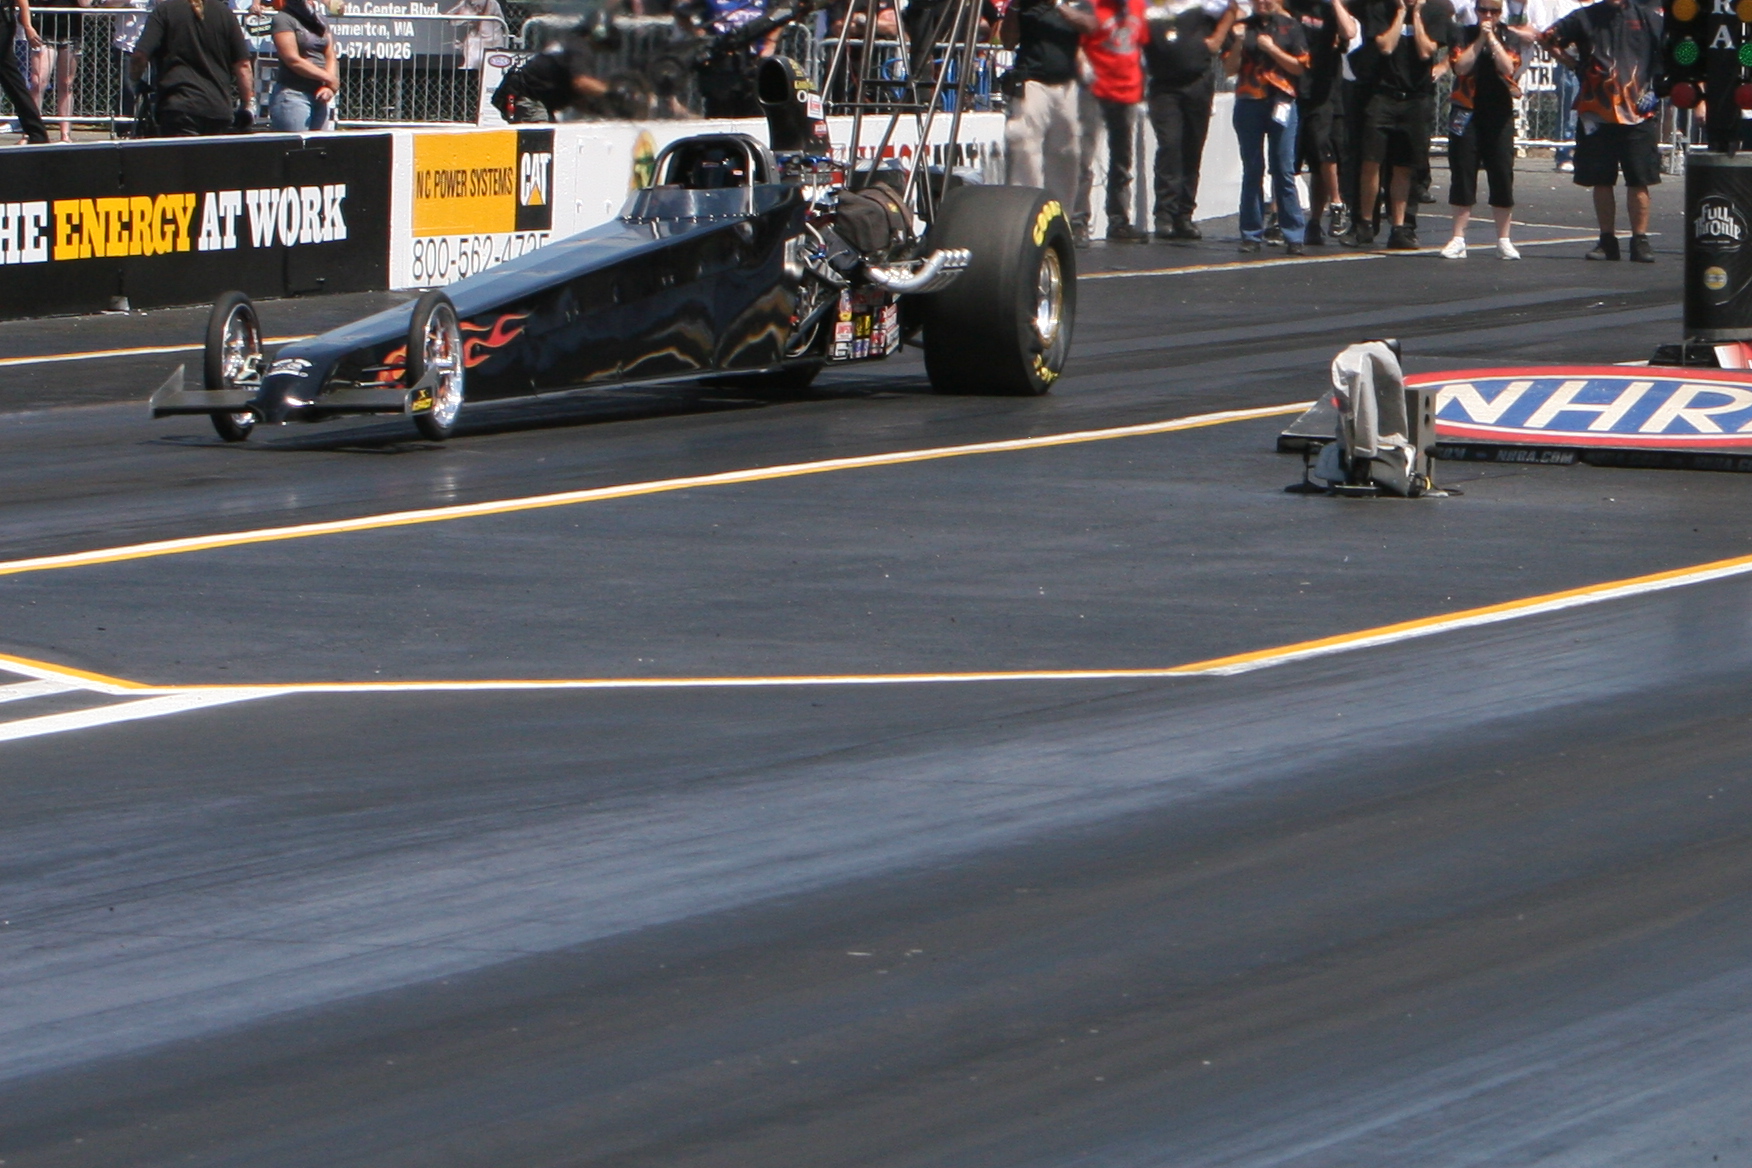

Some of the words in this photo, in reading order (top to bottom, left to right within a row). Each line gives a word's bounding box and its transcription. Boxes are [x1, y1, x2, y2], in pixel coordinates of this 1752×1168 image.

[364, 1, 407, 14] Center
[329, 21, 391, 39] remerton,
[394, 21, 414, 37] WA
[334, 41, 411, 60] 0-671-0026
[434, 169, 467, 199] POWER
[470, 166, 514, 198] SYSTEMS
[519, 151, 551, 207] CAT
[54, 192, 196, 261] ENERGY
[198, 190, 242, 251] AT
[246, 184, 347, 248] WORK
